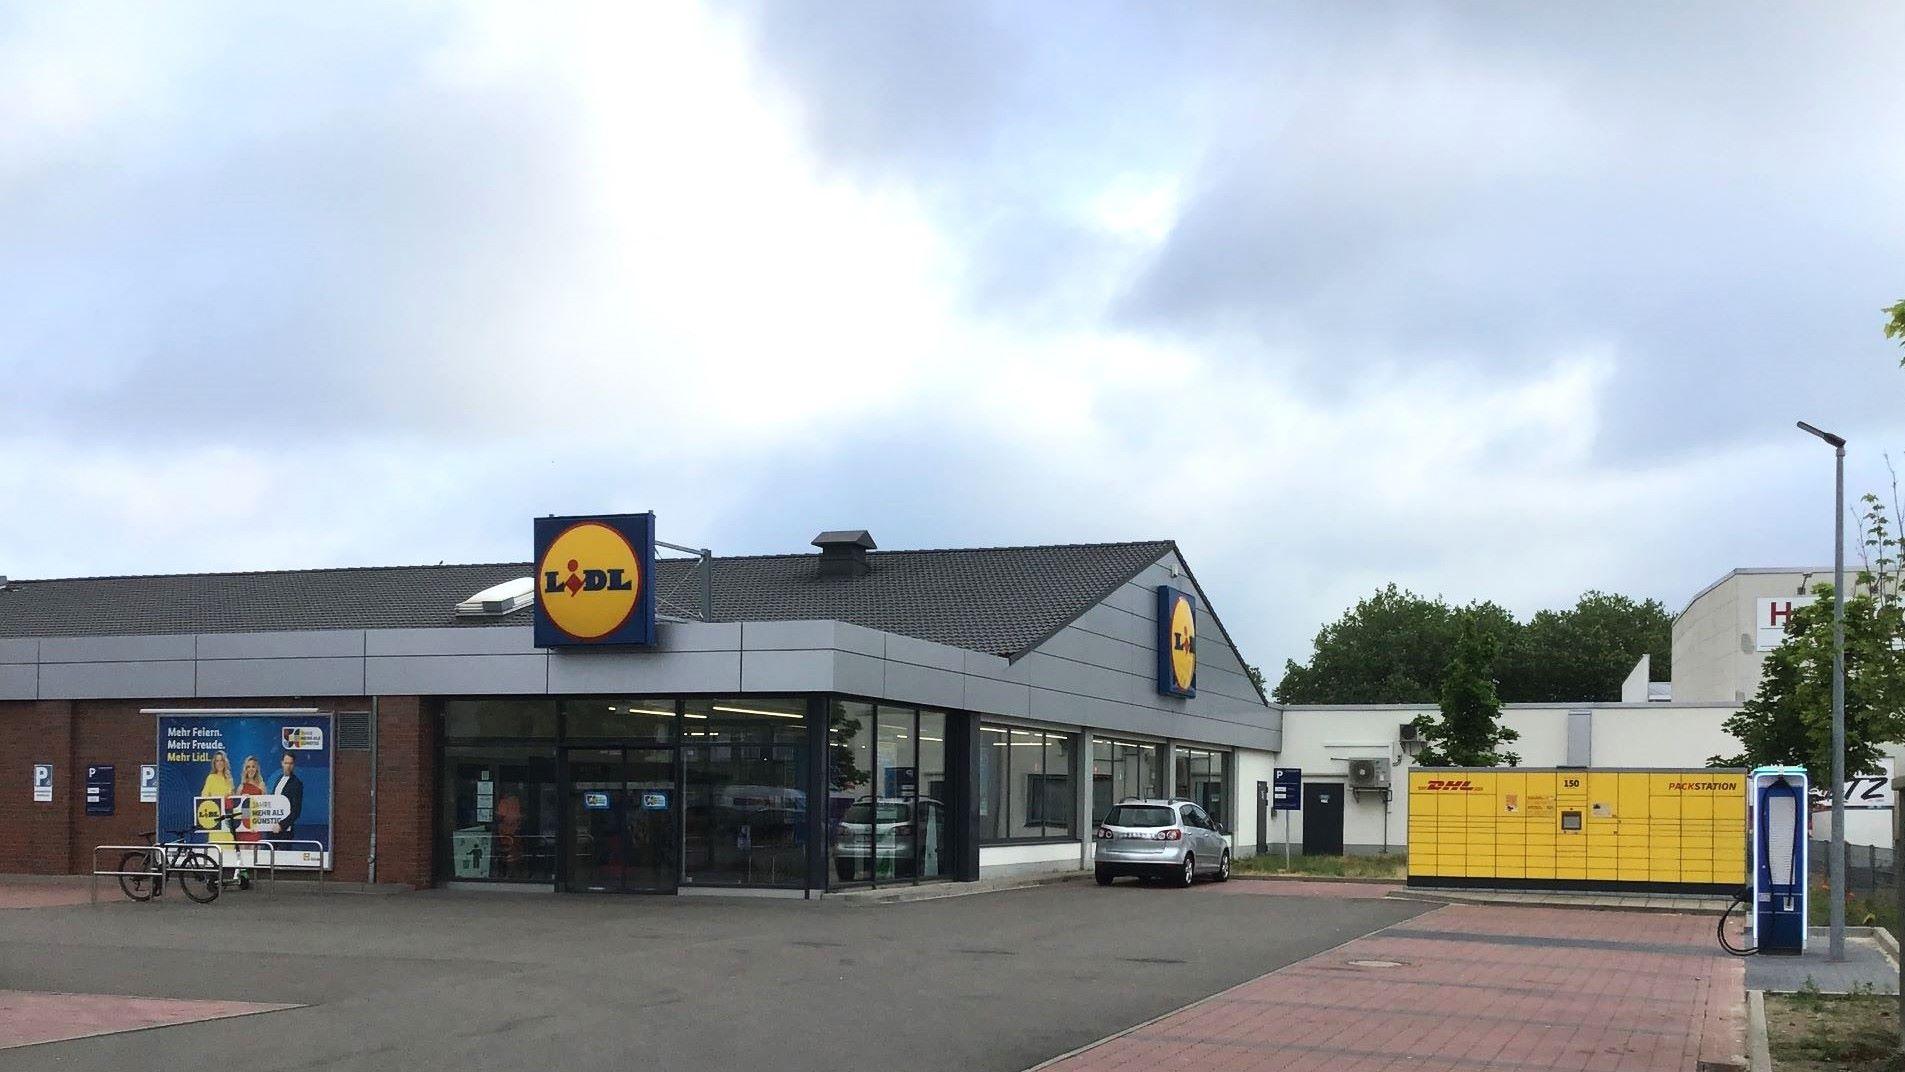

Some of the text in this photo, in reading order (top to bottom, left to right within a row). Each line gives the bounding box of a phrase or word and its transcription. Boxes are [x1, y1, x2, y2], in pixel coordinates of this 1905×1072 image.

[168, 727, 223, 737] Mehr Feiern.
[168, 740, 226, 749] Mehr Freude.
[168, 752, 190, 762] Mehr
[36, 767, 48, 786] P
[88, 768, 97, 778] P
[142, 767, 155, 786] P
[1276, 770, 1283, 778] P
[1427, 781, 1474, 790] DHL
[1563, 779, 1580, 788] 150
[1668, 782, 1737, 791] PACKSTATION
